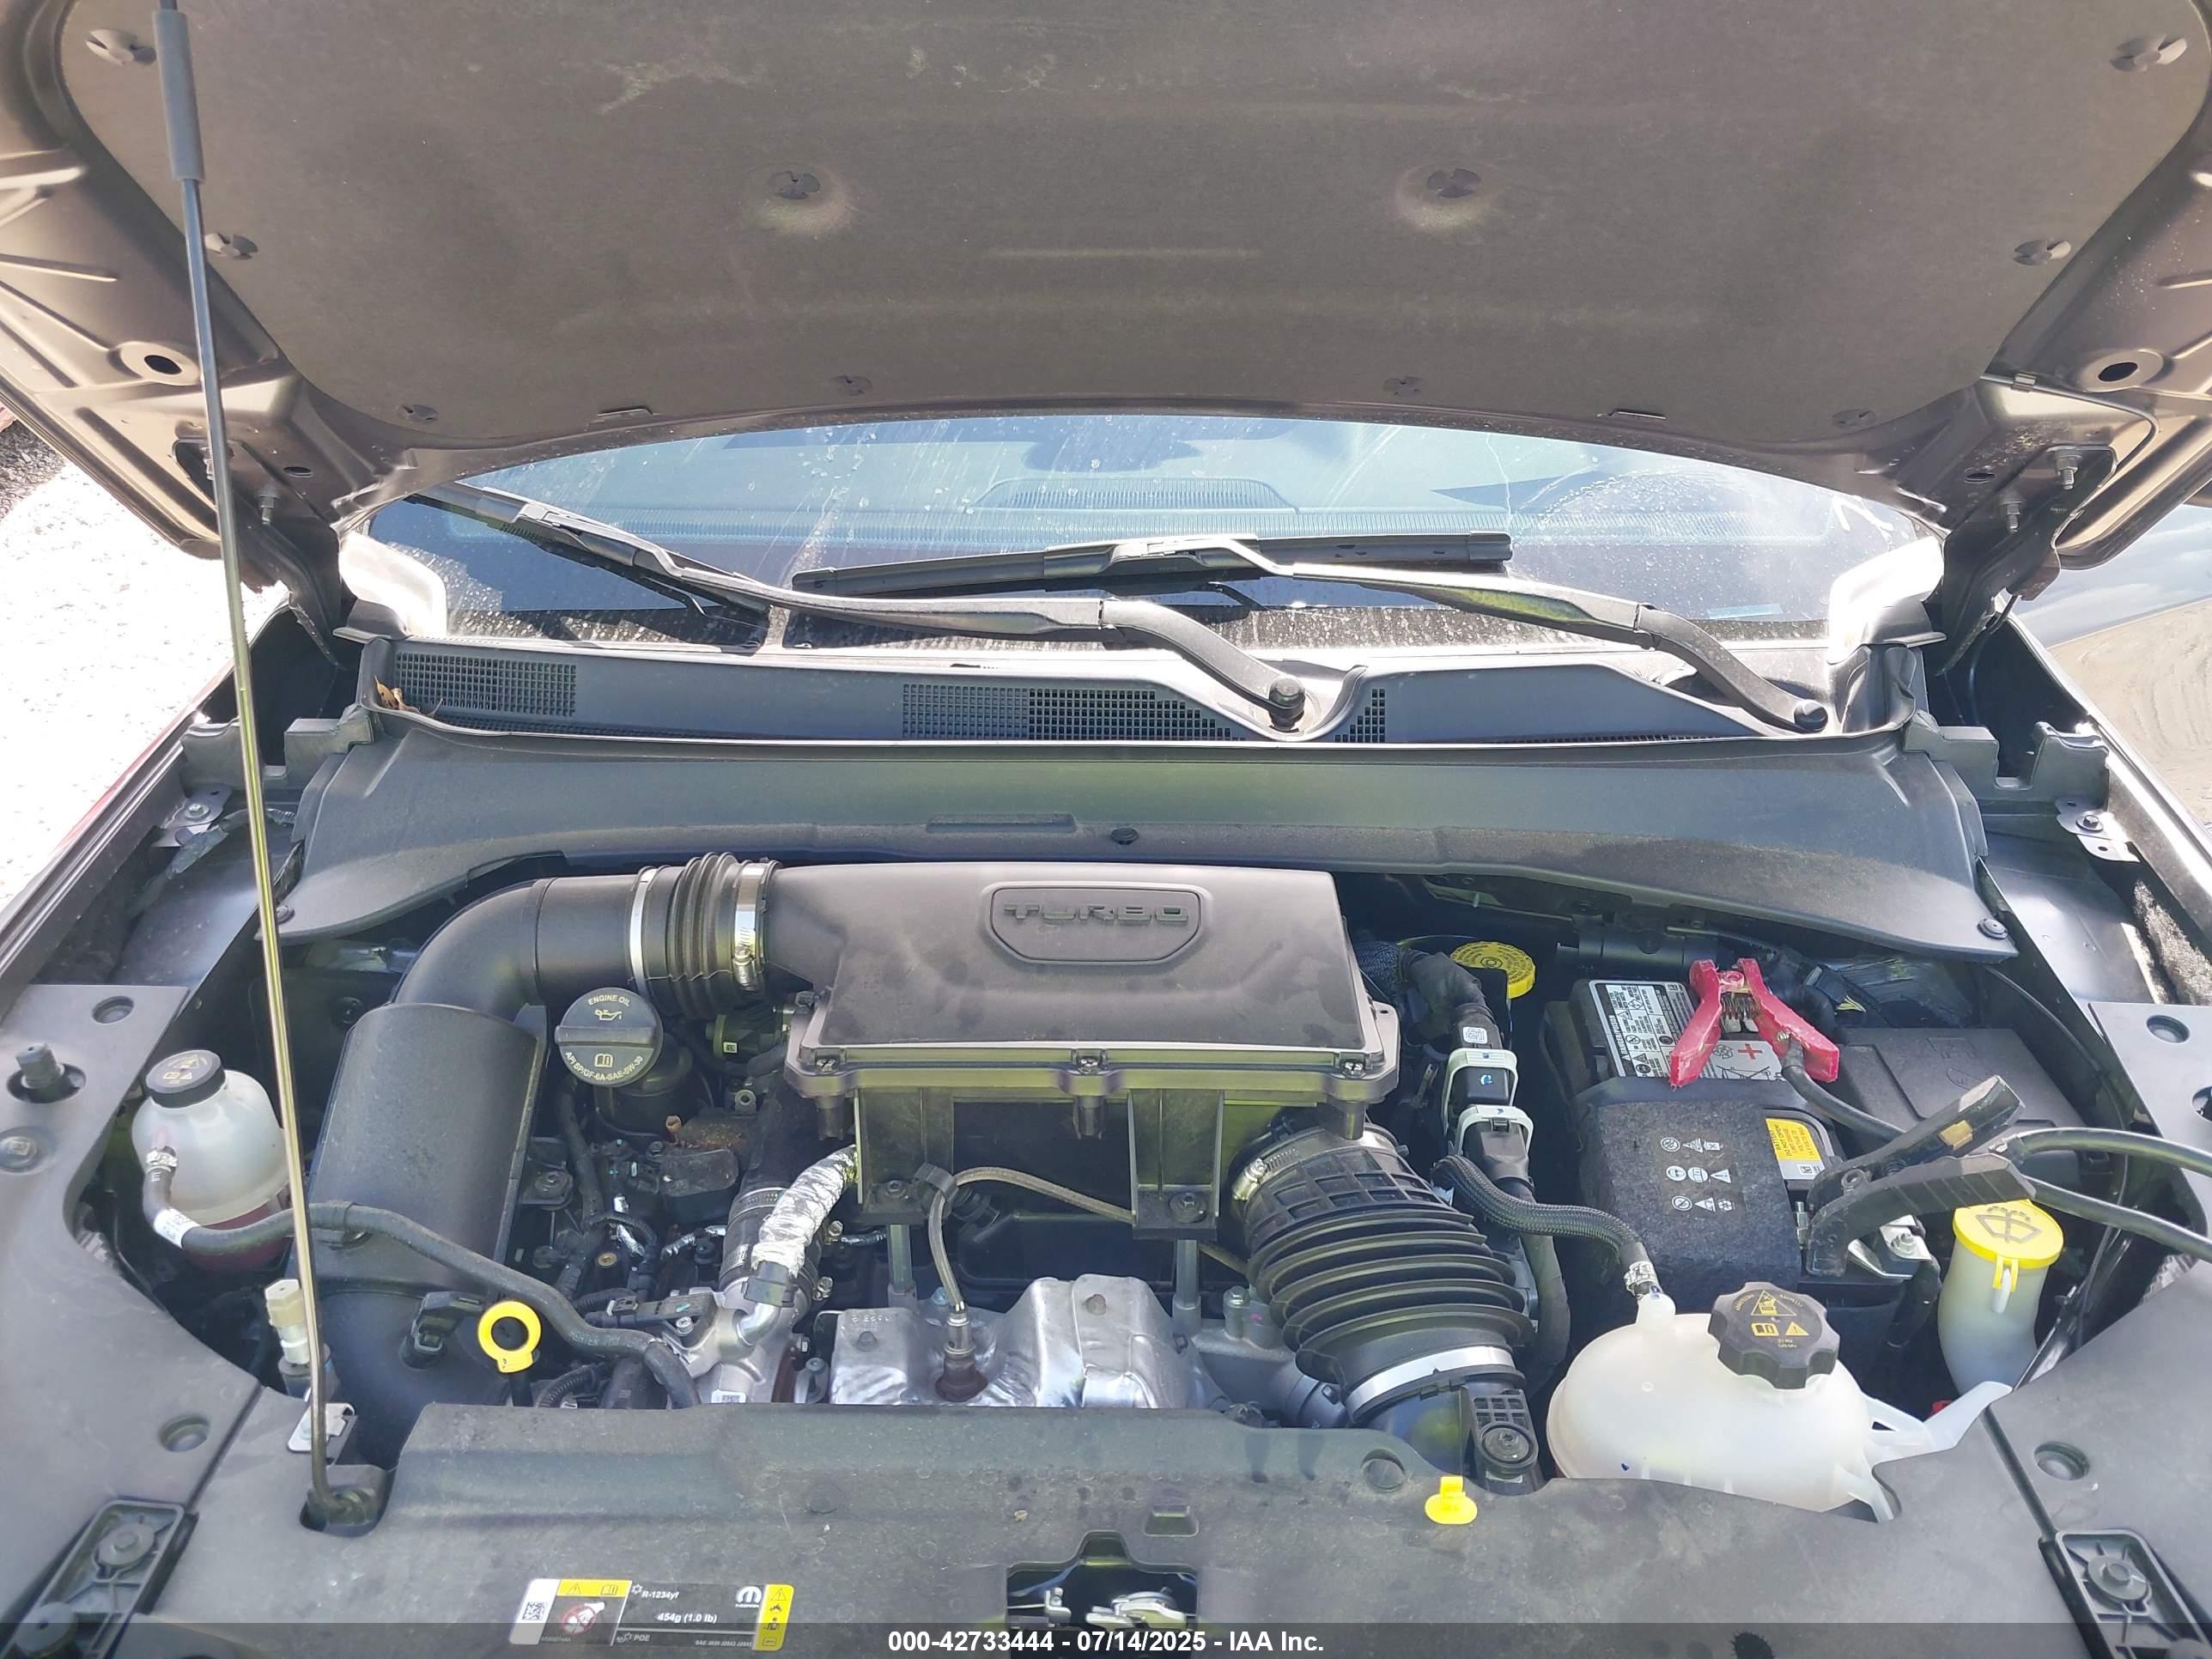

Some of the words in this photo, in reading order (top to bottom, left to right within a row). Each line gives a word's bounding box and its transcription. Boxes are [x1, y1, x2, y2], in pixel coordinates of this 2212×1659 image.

[1004, 904, 1188, 922] TURBO
[587, 994, 618, 1006] ENGINE
[618, 996, 630, 1006] OIL
[565, 1051, 576, 1065] API
[641, 1591, 680, 1600] R-1234yf
[658, 1613, 682, 1623] 454g
[684, 1613, 702, 1623] (1.0
[703, 1613, 718, 1624] lb)
